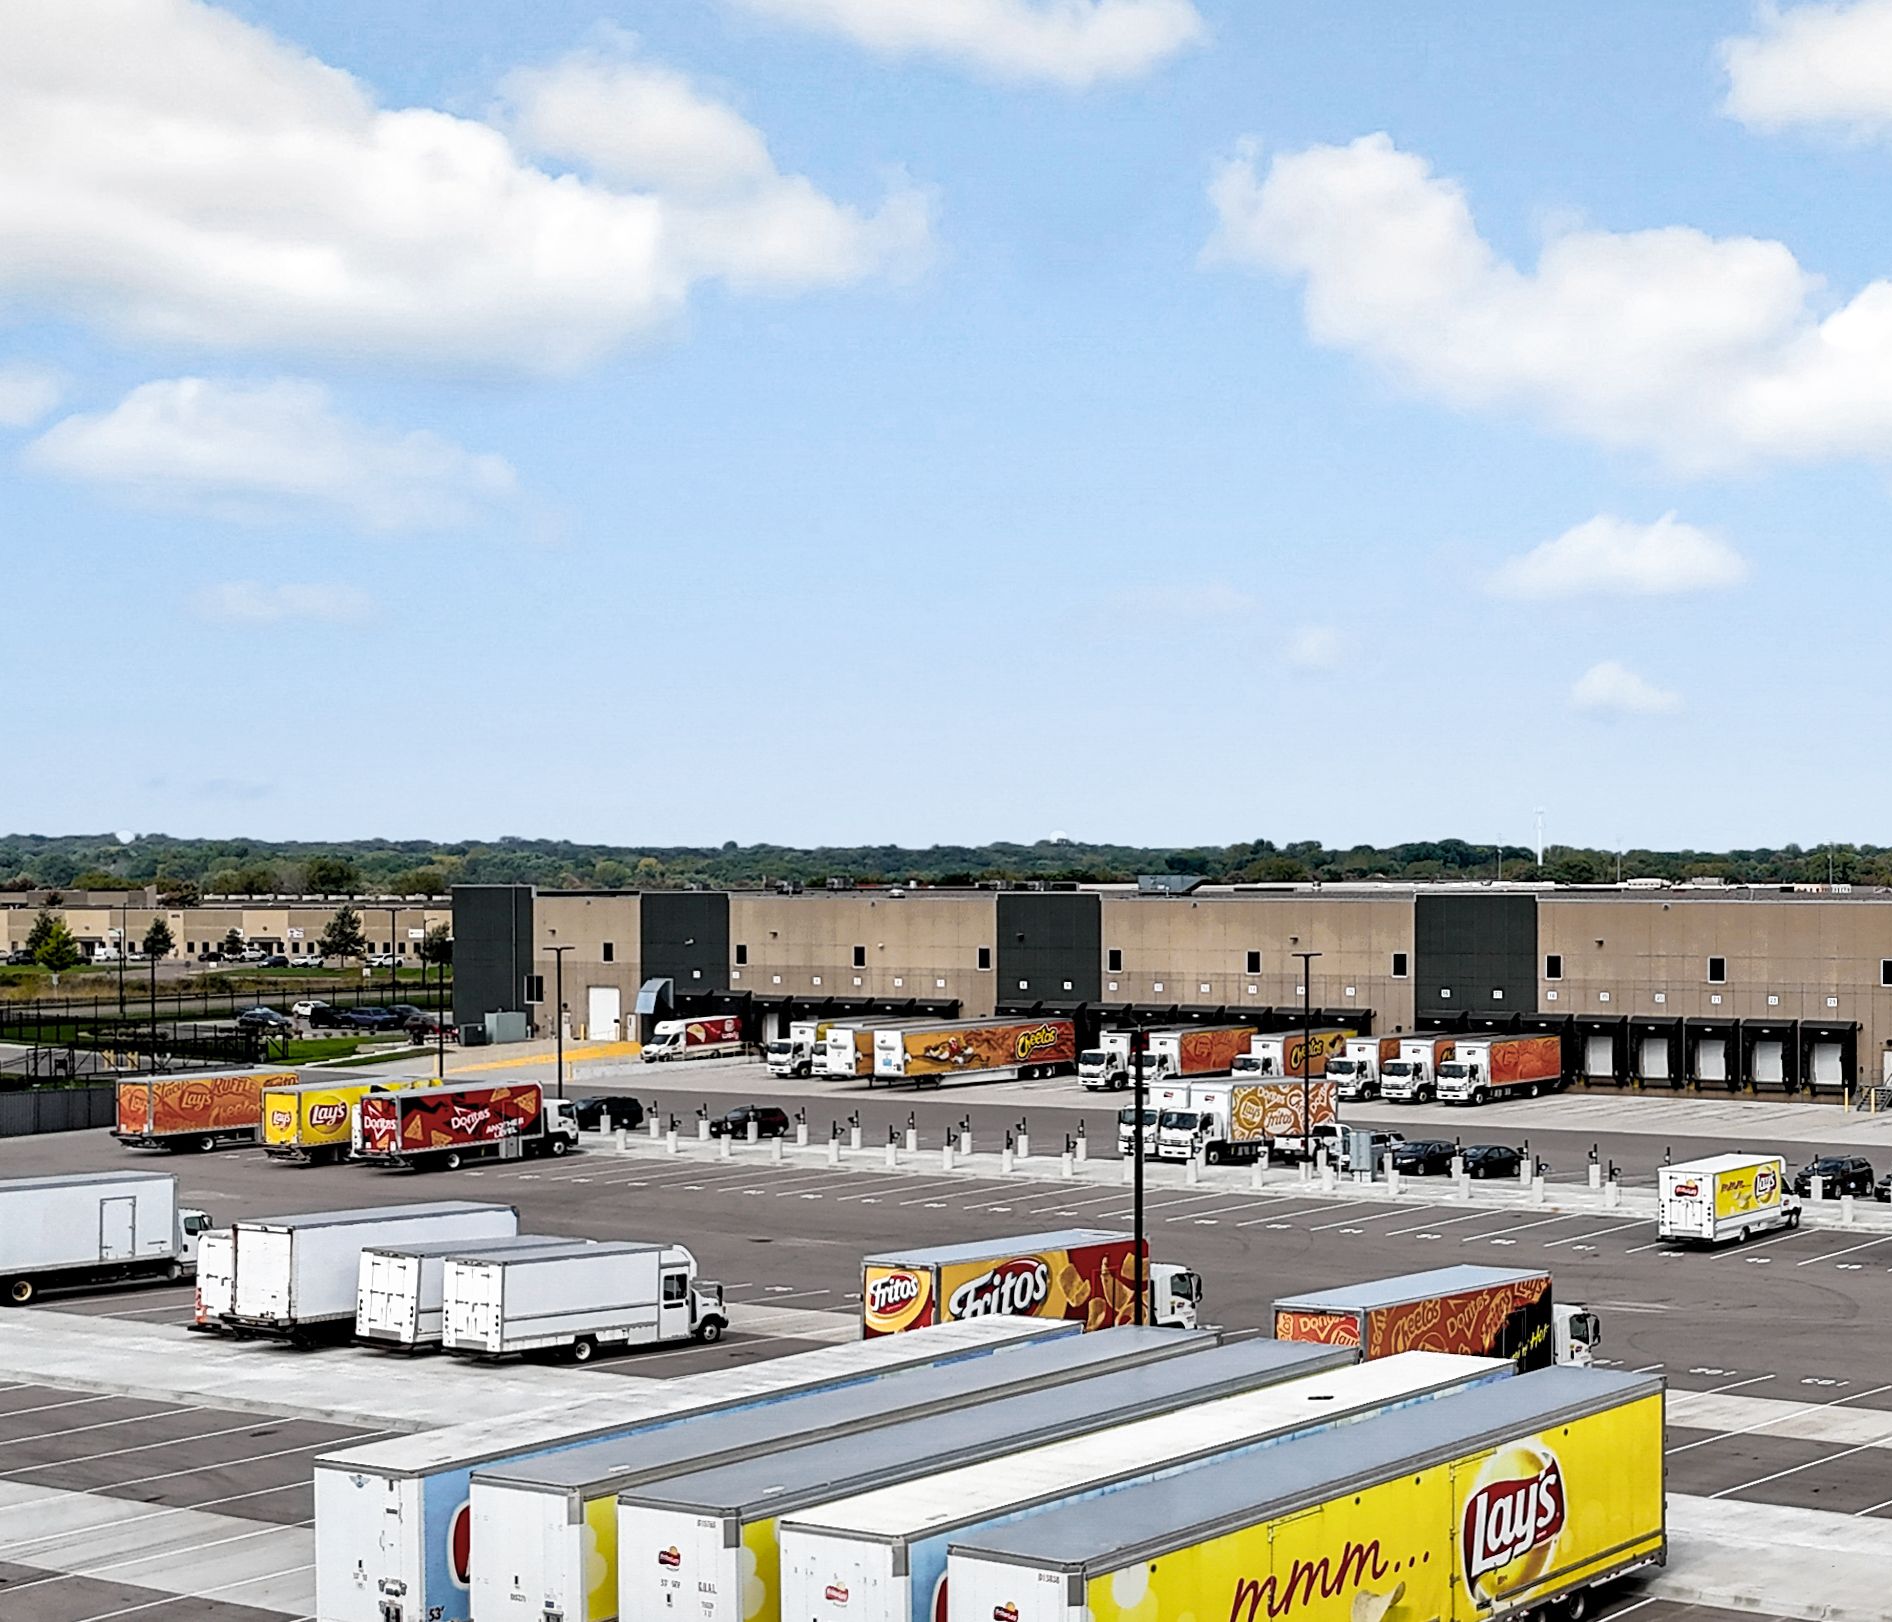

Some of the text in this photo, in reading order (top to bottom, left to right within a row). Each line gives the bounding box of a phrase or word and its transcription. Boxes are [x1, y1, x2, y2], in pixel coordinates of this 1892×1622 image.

[1017, 1025, 1057, 1059] Cheetos
[181, 1091, 212, 1111] Lay's
[311, 1103, 345, 1126] Lay's
[451, 1107, 490, 1134] Doritos
[869, 1275, 919, 1312] Fritos
[949, 1263, 1048, 1318] Fritos
[1447, 1290, 1490, 1339] Doritos
[1471, 1470, 1558, 1577] Lay's
